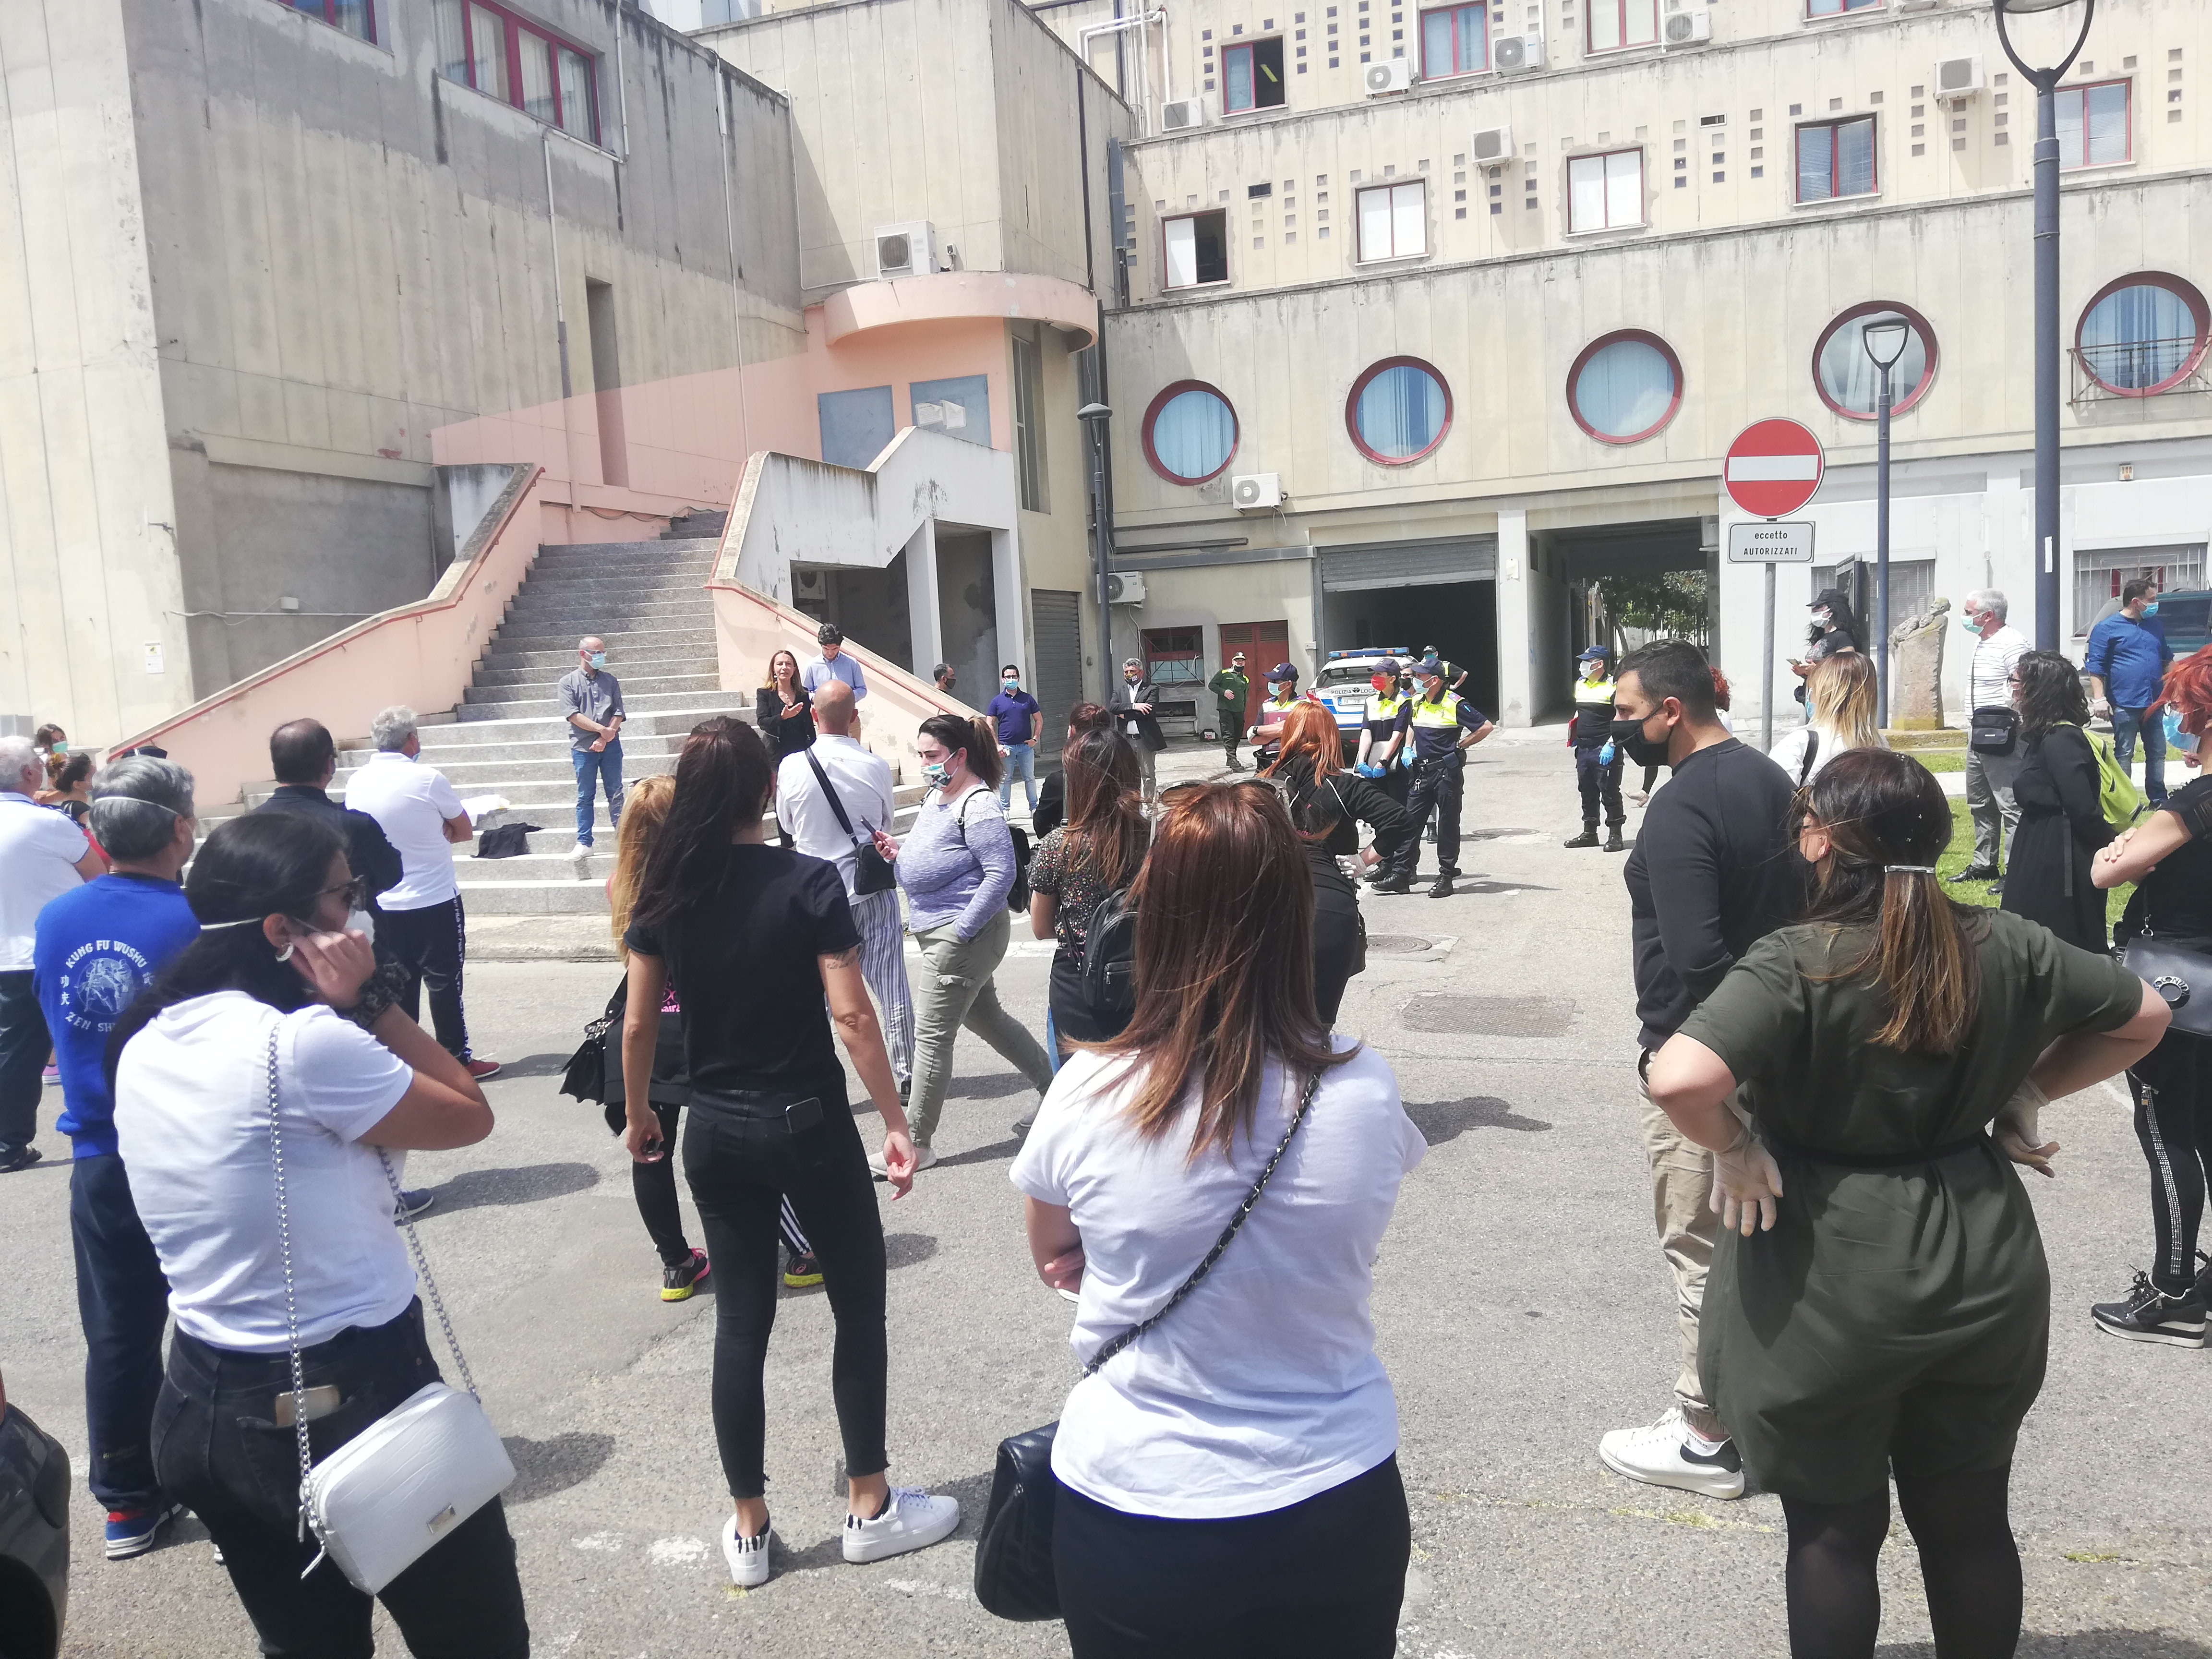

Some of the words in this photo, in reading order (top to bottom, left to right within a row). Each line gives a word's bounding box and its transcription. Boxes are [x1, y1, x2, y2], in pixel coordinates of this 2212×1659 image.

[1755, 530, 1788, 539] eccetto
[1743, 547, 1797, 555] AUTORIZZATI
[65, 943, 93, 969] KUNG
[96, 940, 110, 951] FU
[114, 940, 148, 968] WUSHU
[65, 1011, 92, 1030] ZEN
[97, 1022, 116, 1033] SH
